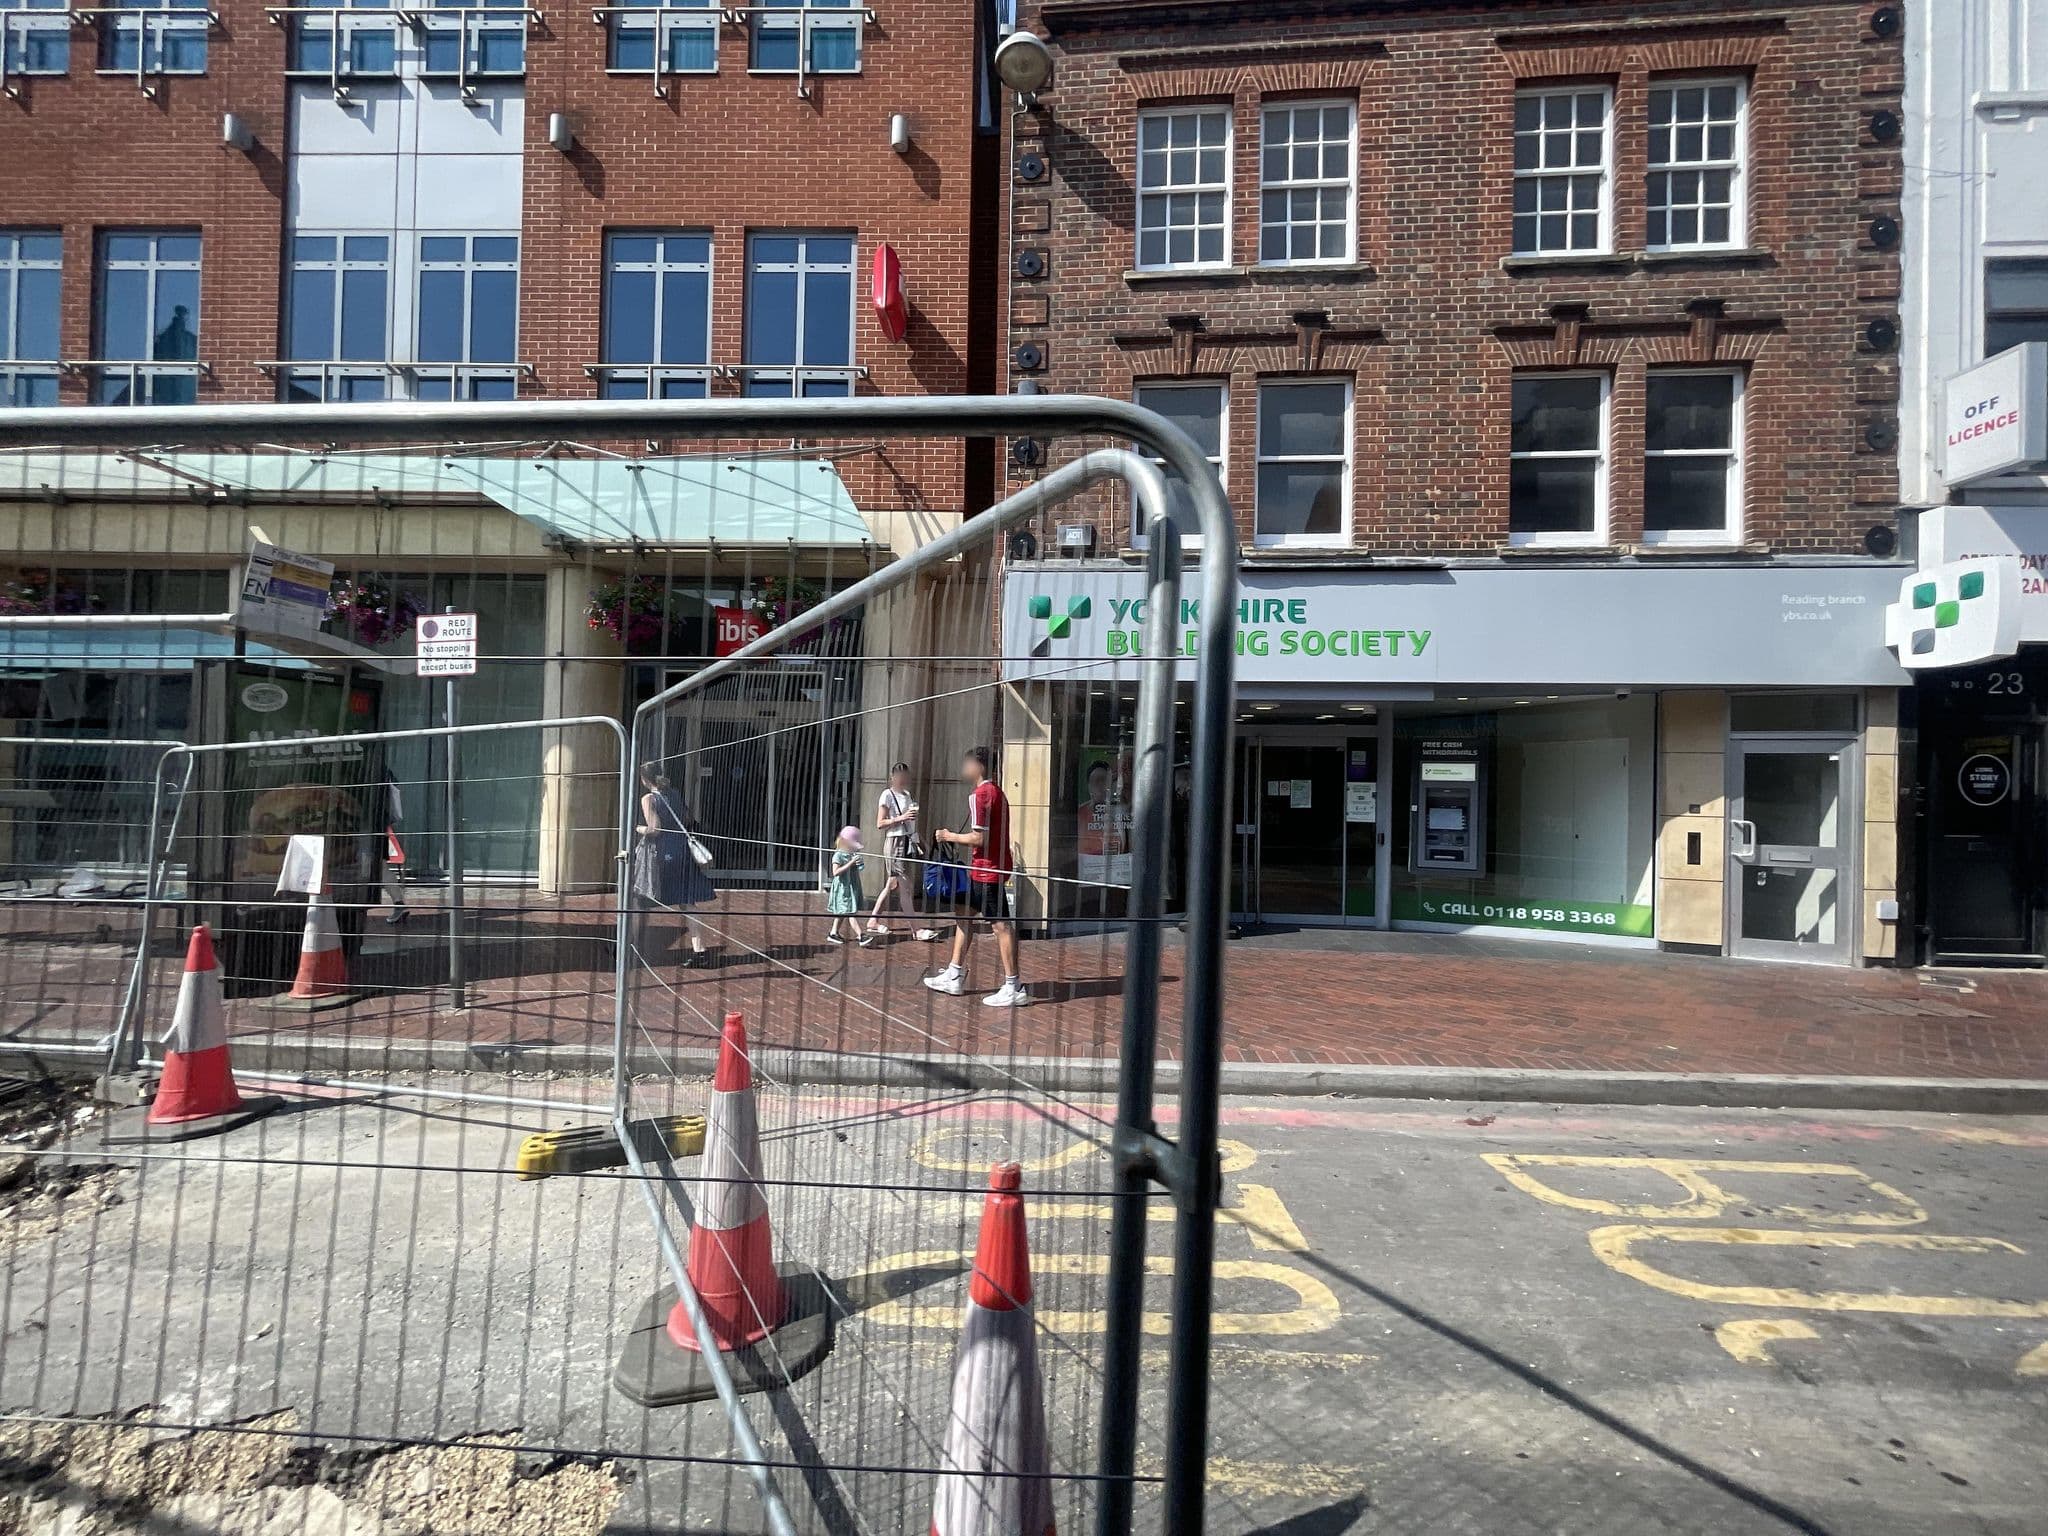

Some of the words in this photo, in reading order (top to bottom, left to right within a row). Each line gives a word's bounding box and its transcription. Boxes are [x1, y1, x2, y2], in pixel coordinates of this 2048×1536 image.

[1964, 396, 1999, 419] OFF
[1948, 411, 2018, 446] LICENCE
[2019, 554, 2048, 570] DAY
[245, 578, 268, 596] FN
[2021, 578, 2048, 594] 2A
[1782, 594, 1826, 607] Reading
[1828, 595, 1866, 604] branch
[1108, 598, 1307, 625] YOKHIRE
[448, 619, 466, 627] RED
[719, 619, 760, 642] ibis
[443, 628, 472, 637] ROUTE
[423, 645, 434, 654] No
[436, 644, 471, 654] stopping
[1279, 630, 1432, 657] SOCIETY
[421, 664, 448, 672] except
[449, 663, 473, 671] buses
[1988, 673, 2024, 695] 23
[1441, 903, 1480, 917] CALL
[1483, 906, 1527, 920] 0118
[1531, 908, 1566, 922] 958
[1569, 910, 1616, 925] 3368
